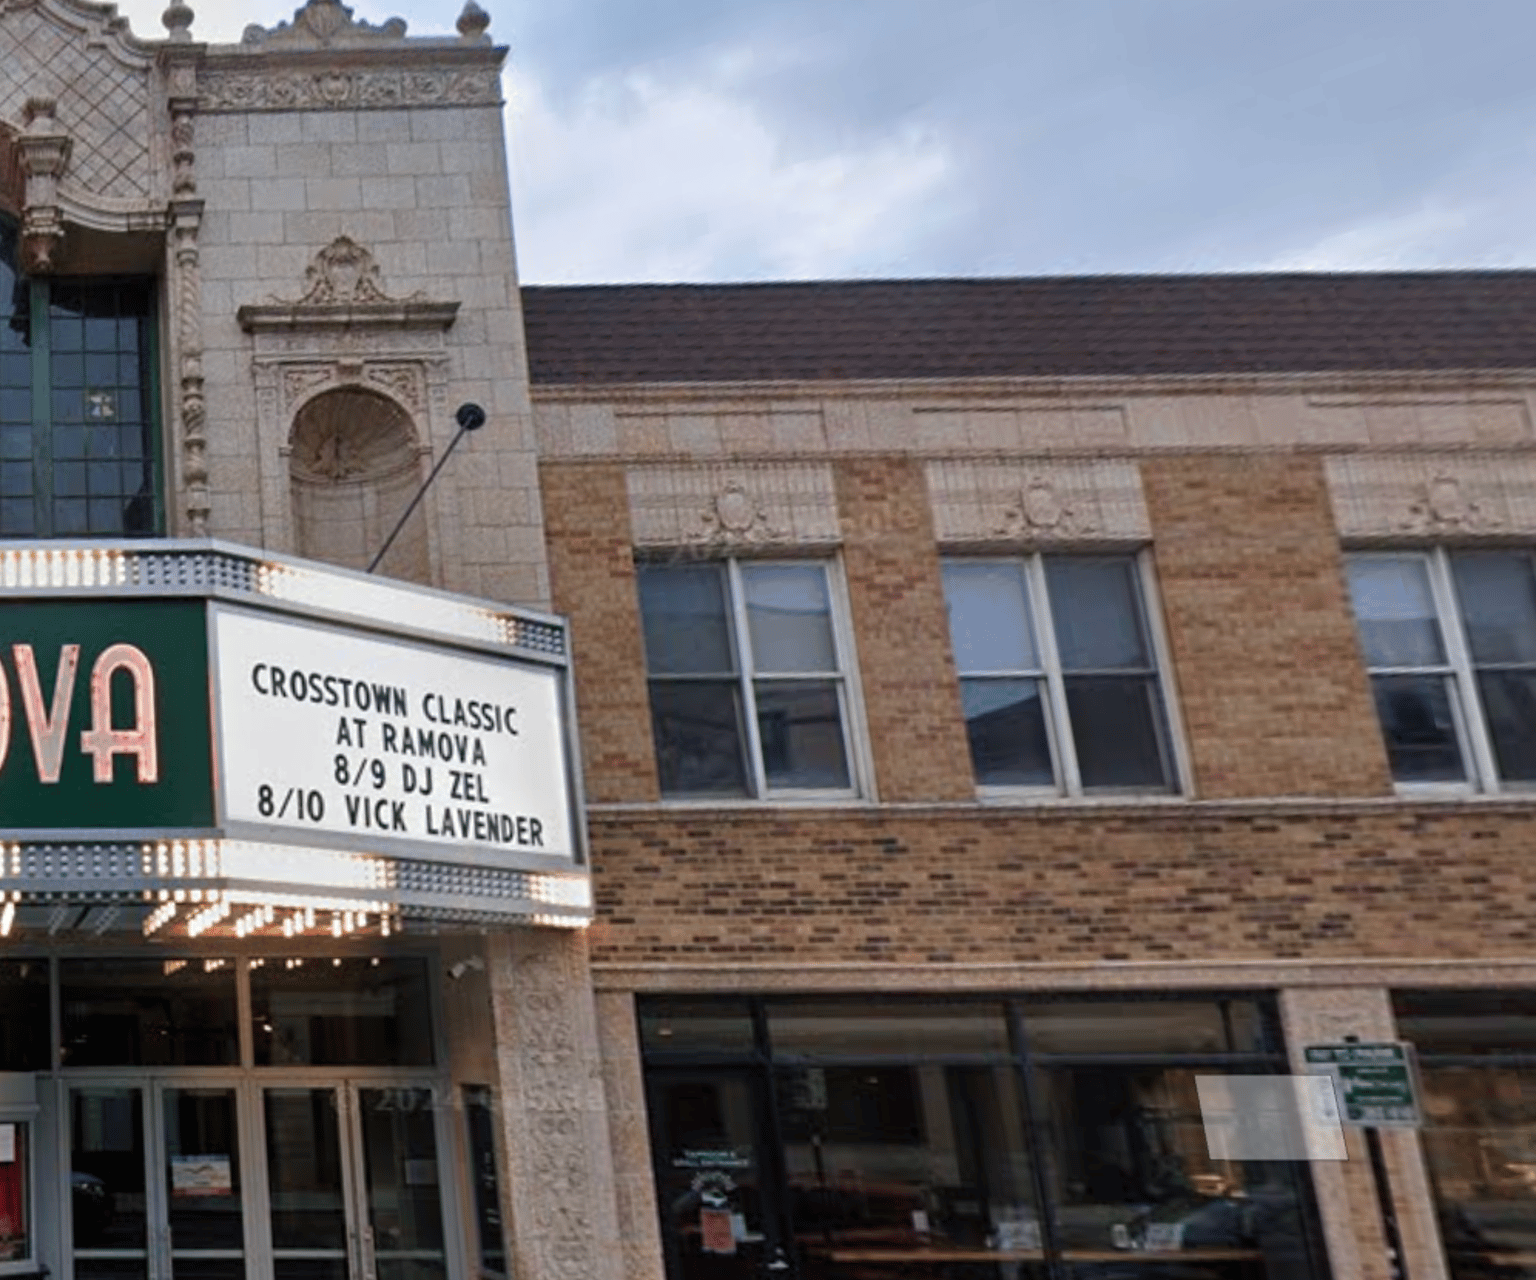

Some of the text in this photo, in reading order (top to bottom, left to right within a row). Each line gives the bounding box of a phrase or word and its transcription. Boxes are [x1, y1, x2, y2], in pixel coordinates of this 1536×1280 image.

[251, 663, 519, 736] CROSSTOWN CLASSIC
[336, 716, 487, 767] AT RAMOVA
[333, 754, 490, 804] 8/9 DJ ZEL
[257, 784, 544, 847] 8/10 VICK LAVENDER
